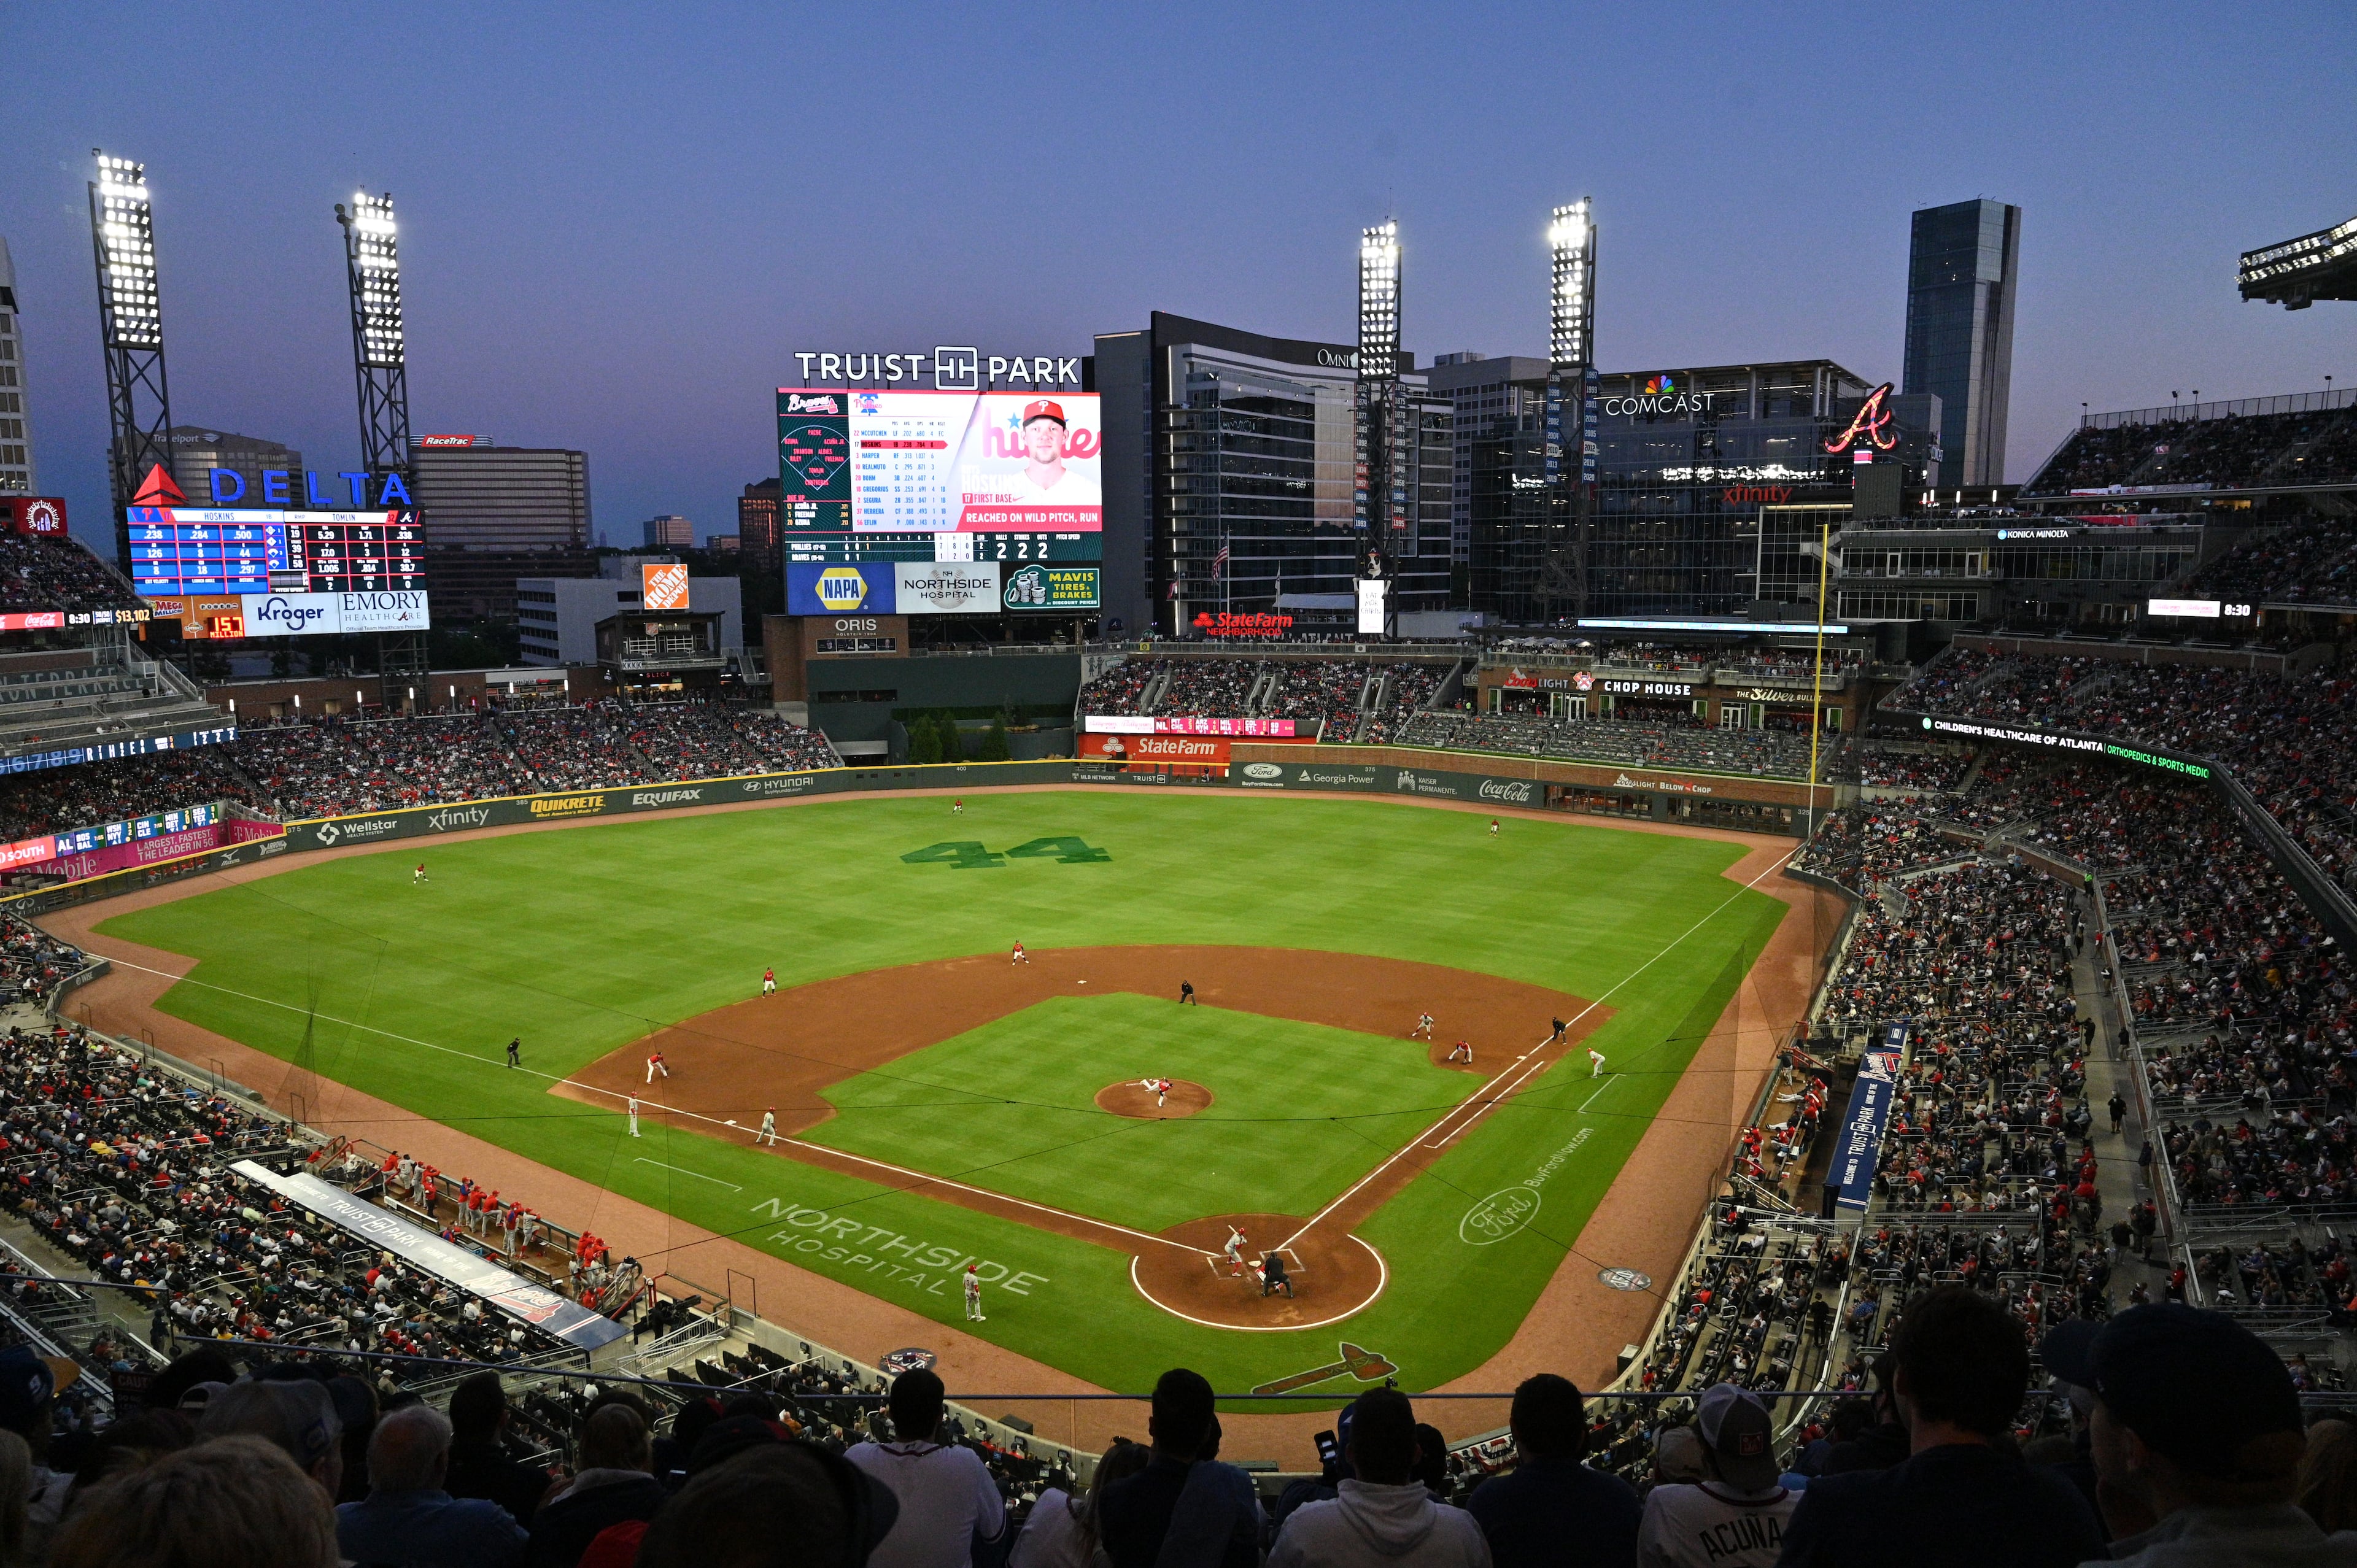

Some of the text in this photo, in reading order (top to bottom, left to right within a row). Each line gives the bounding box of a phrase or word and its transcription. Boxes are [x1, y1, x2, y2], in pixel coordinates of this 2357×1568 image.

[794, 352, 1080, 384] TRUIST PARK
[1549, 388, 1560, 396] 1998
[1548, 403, 1560, 411] 2000
[1605, 393, 1714, 415] COMCAST
[1547, 417, 1559, 425] 2002
[1585, 414, 1597, 423] 2003
[153, 433, 199, 443] Traelport
[1547, 431, 1559, 440] 2004
[1585, 429, 1596, 438] 2005
[425, 436, 470, 447] RaceTrac
[1584, 458, 1595, 467] 2018
[209, 468, 413, 506] DELTA
[974, 493, 1012, 503] FIRST BASE
[1722, 483, 1793, 506] xfinity
[966, 512, 1098, 523] REACHED ON WILD PITCH, RUN
[144, 530, 163, 539] .238
[233, 531, 252, 539] .500
[2007, 530, 2069, 539] KONICA MINOLTA
[996, 542, 1007, 559] 2
[1018, 542, 1028, 559] 2
[1038, 542, 1048, 559] 2
[648, 569, 667, 588] THE
[1048, 572, 1094, 582] MAVIS
[644, 564, 688, 609] HOME
[823, 578, 860, 598] NAPA
[904, 579, 991, 590] NORTHSIDE
[343, 592, 423, 611] EMORY
[662, 581, 688, 609] DEPOT
[155, 600, 183, 610] MEGA
[2224, 604, 2251, 617] 8:30
[68, 613, 90, 624] 8:30
[115, 609, 150, 624] $13,102
[257, 597, 324, 631] Kroger
[345, 611, 422, 622] HEALTHCARE
[215, 617, 243, 631] 157
[835, 619, 877, 631] ORIS
[1206, 627, 1282, 636] NEIGHBORHOOD
[1504, 672, 1568, 689] Coors LIGHT
[1604, 680, 1692, 696] CHOP HOUSE
[1749, 688, 1795, 703] Silver
[1156, 721, 1168, 730] NL
[1934, 720, 1983, 736] CHILDREN'S
[1983, 727, 2042, 744] HEALTHCARE
[2043, 735, 2057, 746] OF
[2058, 736, 2103, 752] ATLANTA
[2107, 745, 2151, 765] ORTHOPEDICS
[2151, 756, 2157, 765] &
[2158, 757, 2185, 771] SPORTS
[1247, 765, 1274, 778] Ford
[764, 776, 814, 789] HYUNDAI
[1313, 774, 1374, 785] Georgia Power
[1418, 777, 1437, 786] KAISER
[1616, 776, 1638, 787] Coors
[1659, 782, 1684, 791] BELOW
[1692, 785, 1711, 794] CHOP
[1418, 785, 1456, 795] PERMANENTE
[530, 795, 605, 813] QUIKRETE
[632, 789, 702, 806] EQUIFAX
[165, 813, 179, 822] MIN
[192, 807, 206, 816] SEA
[428, 806, 490, 830] xfinity
[165, 820, 179, 829] DET
[193, 814, 206, 823] TEX
[106, 824, 122, 833] WSH
[136, 821, 150, 830] CIN
[343, 819, 398, 834] Wellstar
[76, 832, 90, 842] BOS
[107, 832, 122, 841] NYY
[137, 828, 151, 838] CLE
[58, 838, 74, 852] AL
[77, 841, 92, 850] BAL
[136, 829, 213, 852] LARGEST. FASTEST.
[7, 844, 45, 862] SOUTH
[137, 838, 214, 862] THE LEADER IN 5G
[899, 836, 1113, 870] 44
[1857, 1106, 1875, 1124] PARK
[1848, 1131, 1868, 1156] TRUIST
[1523, 1127, 1594, 1187] BuyFordNow.com
[1843, 1163, 1857, 1184] WELCOME
[288, 1180, 424, 1248] WELCOME TRUIST PARK
[1470, 1195, 1532, 1237] Ford
[749, 1197, 1050, 1296] NORTHSIDE
[766, 1230, 948, 1296] HOSPITAL
[1698, 1512, 1783, 1562] ACUÑA
